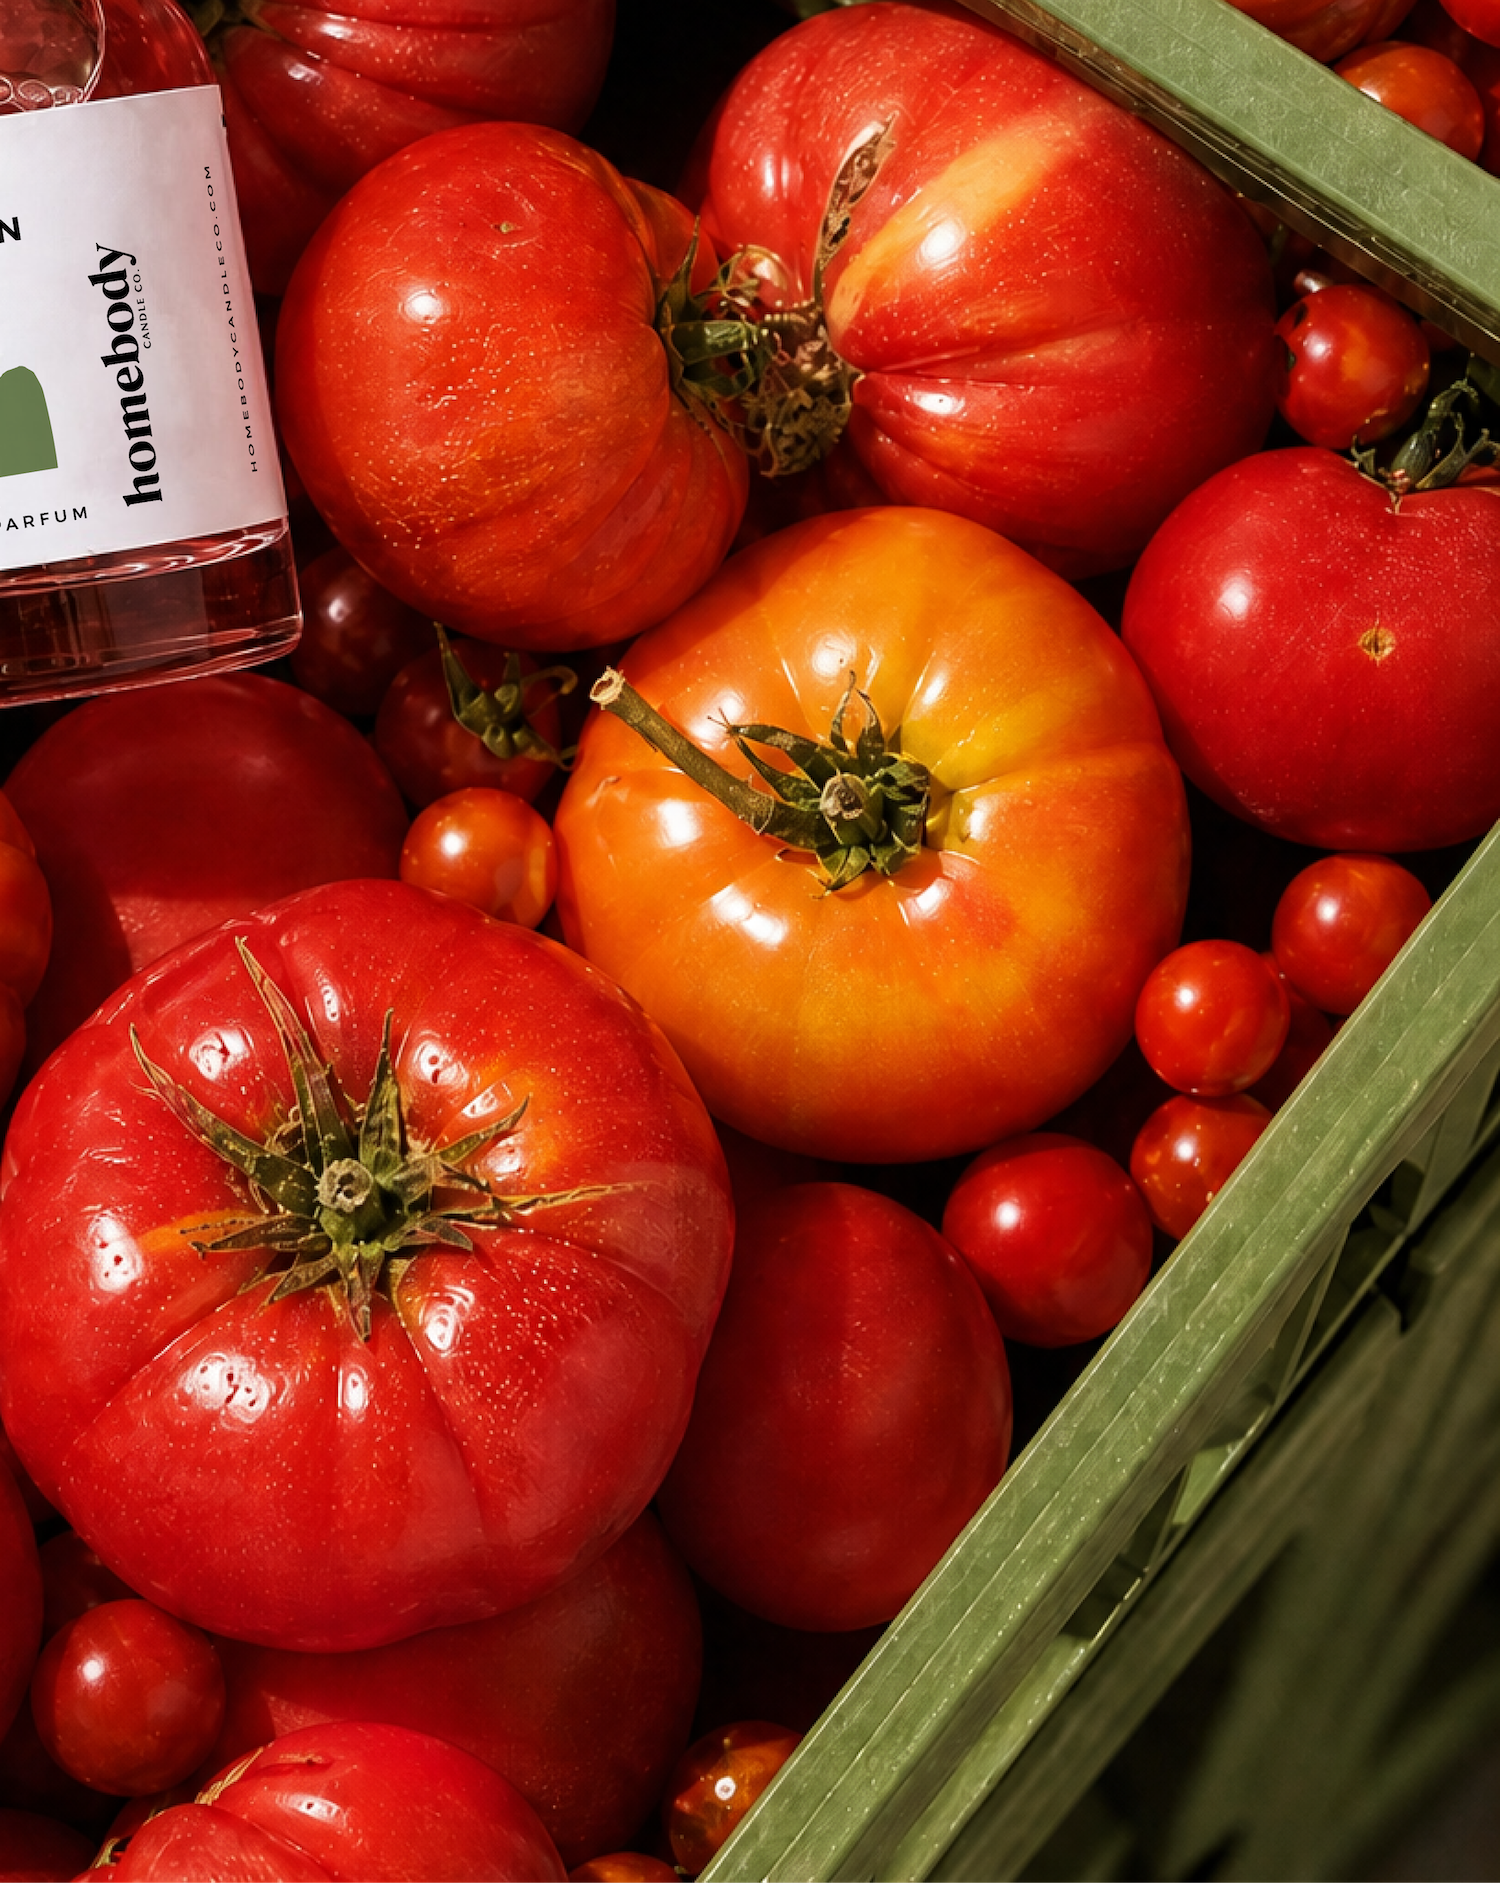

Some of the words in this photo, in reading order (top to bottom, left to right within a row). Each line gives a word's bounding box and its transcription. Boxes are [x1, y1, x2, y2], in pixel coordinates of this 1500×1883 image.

[132, 269, 143, 293] CO.
[136, 298, 152, 349] CANDLE
[203, 166, 259, 473] HOMEBODYCANDLECO.COM
[88, 242, 164, 508] homebody
